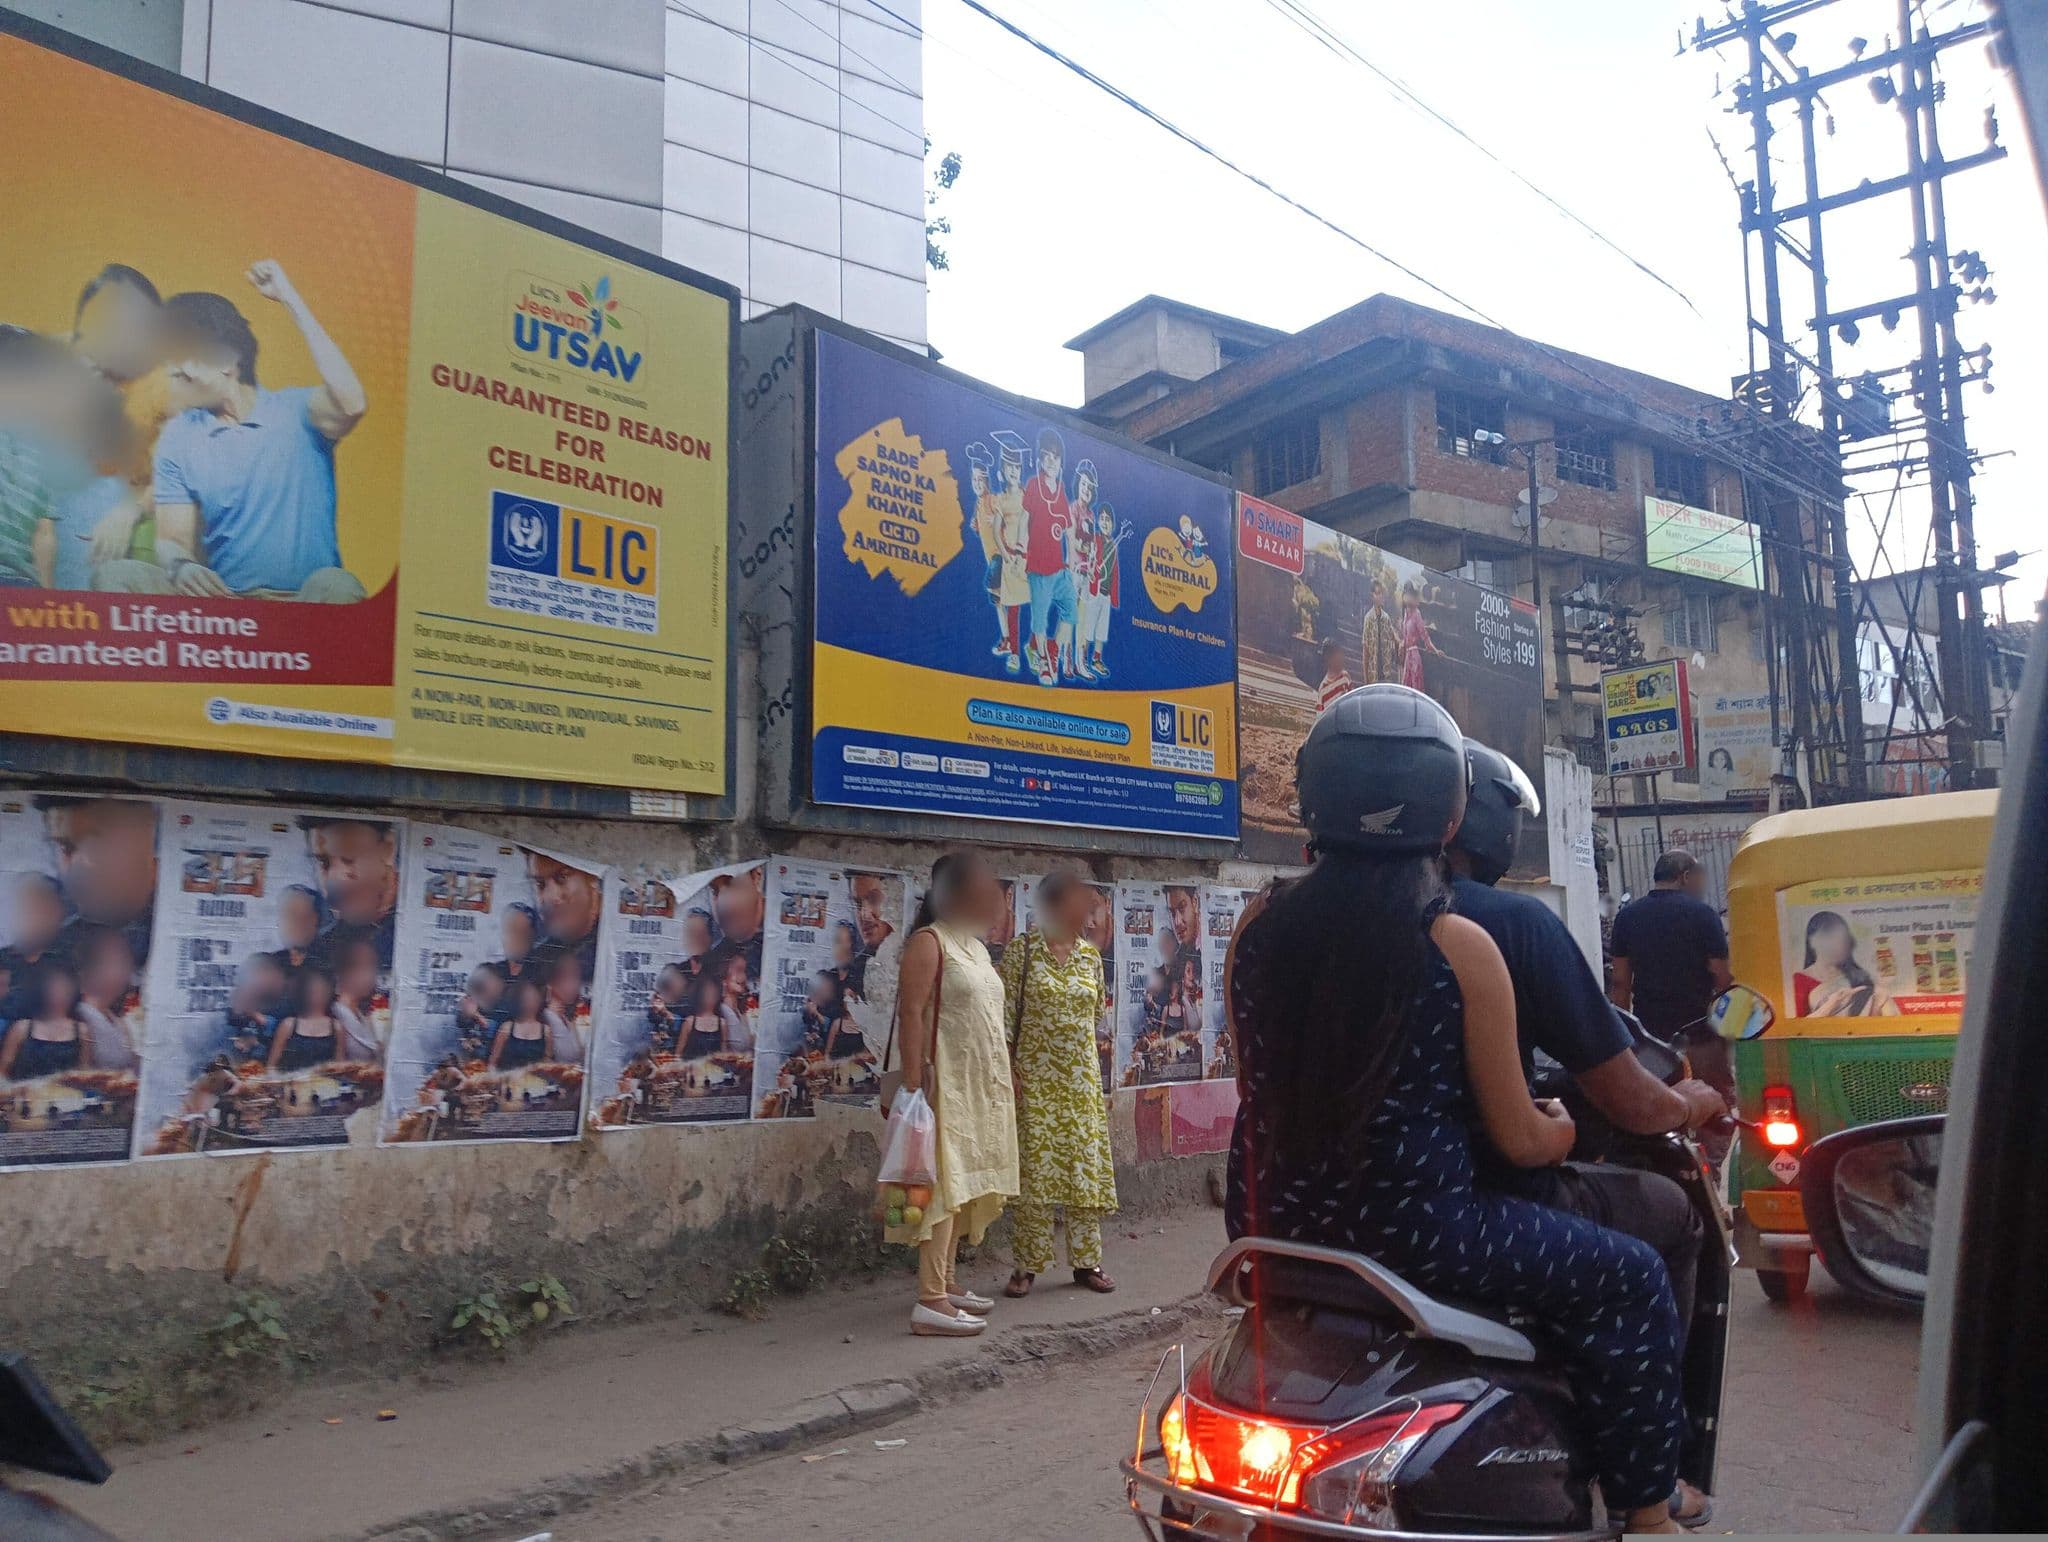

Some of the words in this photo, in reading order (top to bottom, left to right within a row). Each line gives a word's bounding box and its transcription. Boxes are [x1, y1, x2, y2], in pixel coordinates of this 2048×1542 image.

[515, 294, 589, 331] Jeevan
[513, 312, 642, 382] UTSAV
[431, 363, 611, 432] GUARANTEED
[618, 415, 712, 461] REASON
[555, 430, 606, 462] FOR
[877, 443, 919, 470] BADE
[488, 446, 664, 508] CELEBRATION
[857, 456, 912, 484] SAPNO
[915, 474, 936, 493] KA
[871, 477, 923, 506] RAKHE
[867, 494, 927, 524] KHAYAL
[1257, 513, 1300, 543] SMART
[571, 518, 647, 585] LIC
[852, 530, 938, 568] AMRITBAAL
[1256, 535, 1300, 563] BAZAAR
[1144, 555, 1211, 590] AMRITBAAL
[8, 601, 99, 631] with
[109, 604, 259, 638] Lifetime
[1480, 591, 1510, 619] 2000+
[1132, 616, 1167, 633] Insurance
[1168, 625, 1184, 637] Plan
[1185, 629, 1196, 641] for
[1197, 632, 1226, 648] Children
[1475, 611, 1511, 642] Fashion
[177, 641, 312, 671] Returns
[415, 623, 431, 638] For
[434, 630, 460, 642] more
[464, 632, 496, 648] details
[569, 650, 594, 663] terms
[597, 653, 614, 666] and
[664, 664, 691, 678] please
[694, 669, 712, 682] read
[1483, 637, 1512, 664] Styles
[413, 647, 440, 661] sales
[442, 650, 487, 668] brochure
[532, 664, 563, 679] before
[565, 671, 614, 689] concluding
[239, 705, 268, 721] Also
[270, 708, 333, 728] Available
[335, 715, 378, 733] Online
[460, 711, 485, 728] LIFE
[488, 715, 554, 736] INSURANCE
[556, 723, 587, 738] PLAN
[972, 704, 993, 720] Plan
[995, 710, 1003, 721] is
[1005, 711, 1025, 724] also
[1026, 715, 1067, 730] available
[1068, 721, 1095, 736] online
[1095, 725, 1108, 737] for
[1109, 727, 1128, 740] sale
[1180, 711, 1209, 746] LIC
[1616, 718, 1669, 737] BAGS
[1094, 751, 1117, 763] Savings
[1118, 752, 1131, 763] Plan
[1775, 1161, 1796, 1172] CNG
